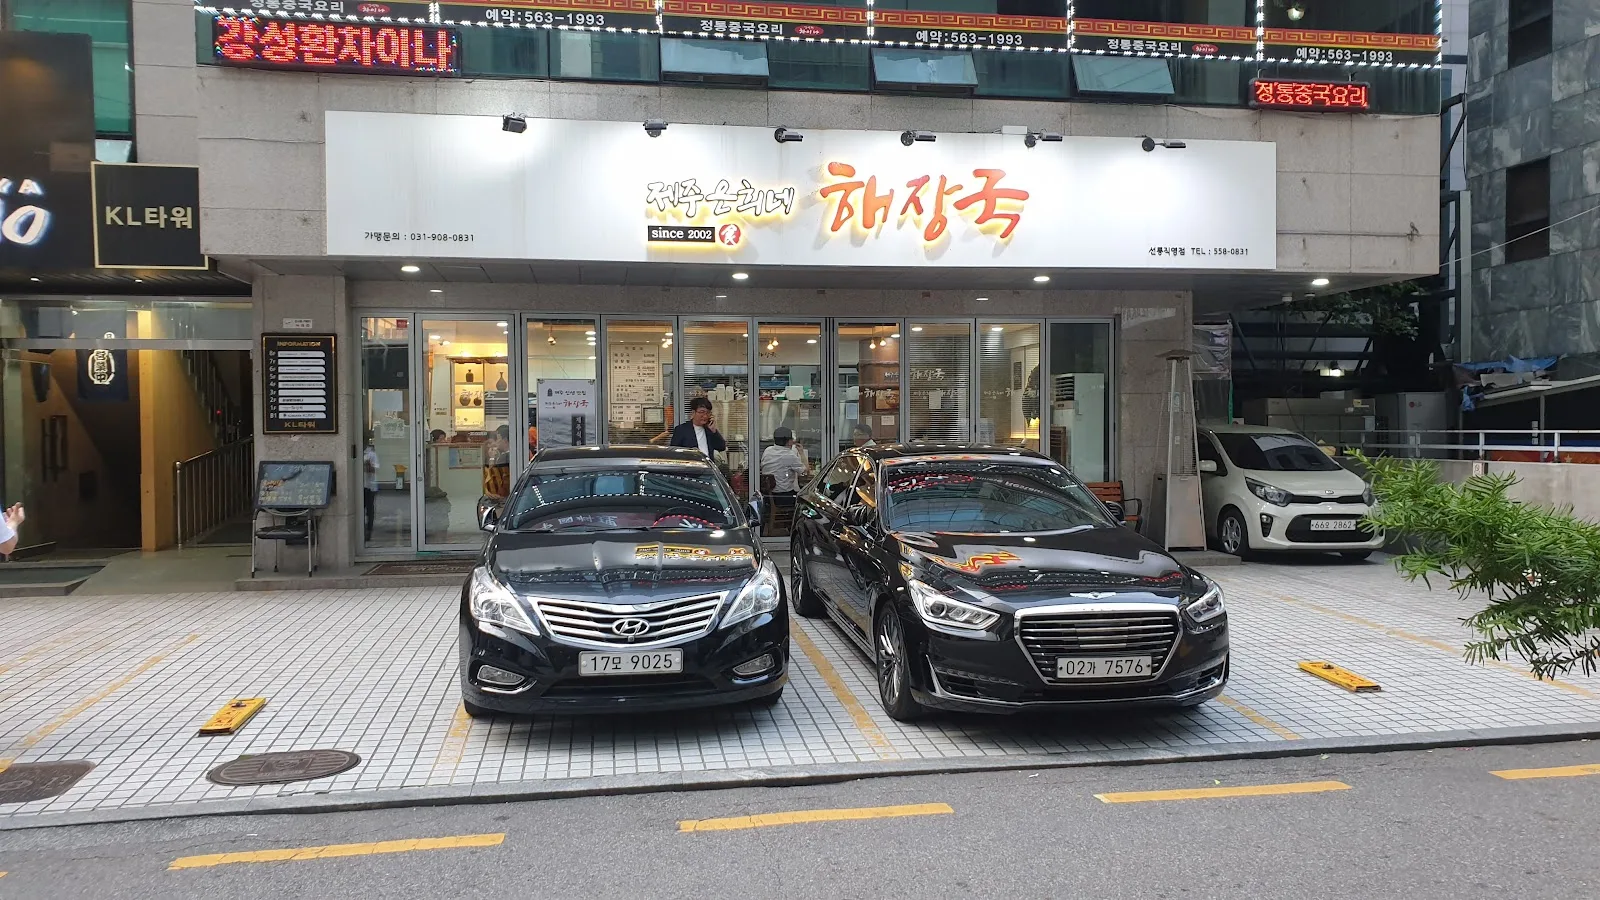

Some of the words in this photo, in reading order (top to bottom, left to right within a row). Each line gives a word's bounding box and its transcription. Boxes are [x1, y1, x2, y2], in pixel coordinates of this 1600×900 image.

[485, 8, 605, 26] 예약:563-1993
[700, 20, 783, 35] 정통중국요리
[916, 30, 1023, 45] 예약:563-1993
[1107, 38, 1182, 53] 정통중국요리
[1296, 47, 1393, 62] 예약:563-1993
[1256, 82, 1366, 106] 정통중국요리
[819, 161, 1030, 241] 해장국
[105, 205, 193, 229] KL타워
[364, 231, 400, 241] 가맹문의
[410, 233, 475, 242] 031-908-0831
[651, 226, 684, 239] since
[687, 229, 713, 240] 2002
[1190, 247, 1206, 256] TEL
[1213, 247, 1249, 256] 558-0831
[1333, 521, 1352, 529] 2862
[590, 656, 622, 671] 17모
[630, 654, 673, 670] 9025
[1066, 660, 1097, 675] 02가
[1104, 658, 1143, 675] 7576
